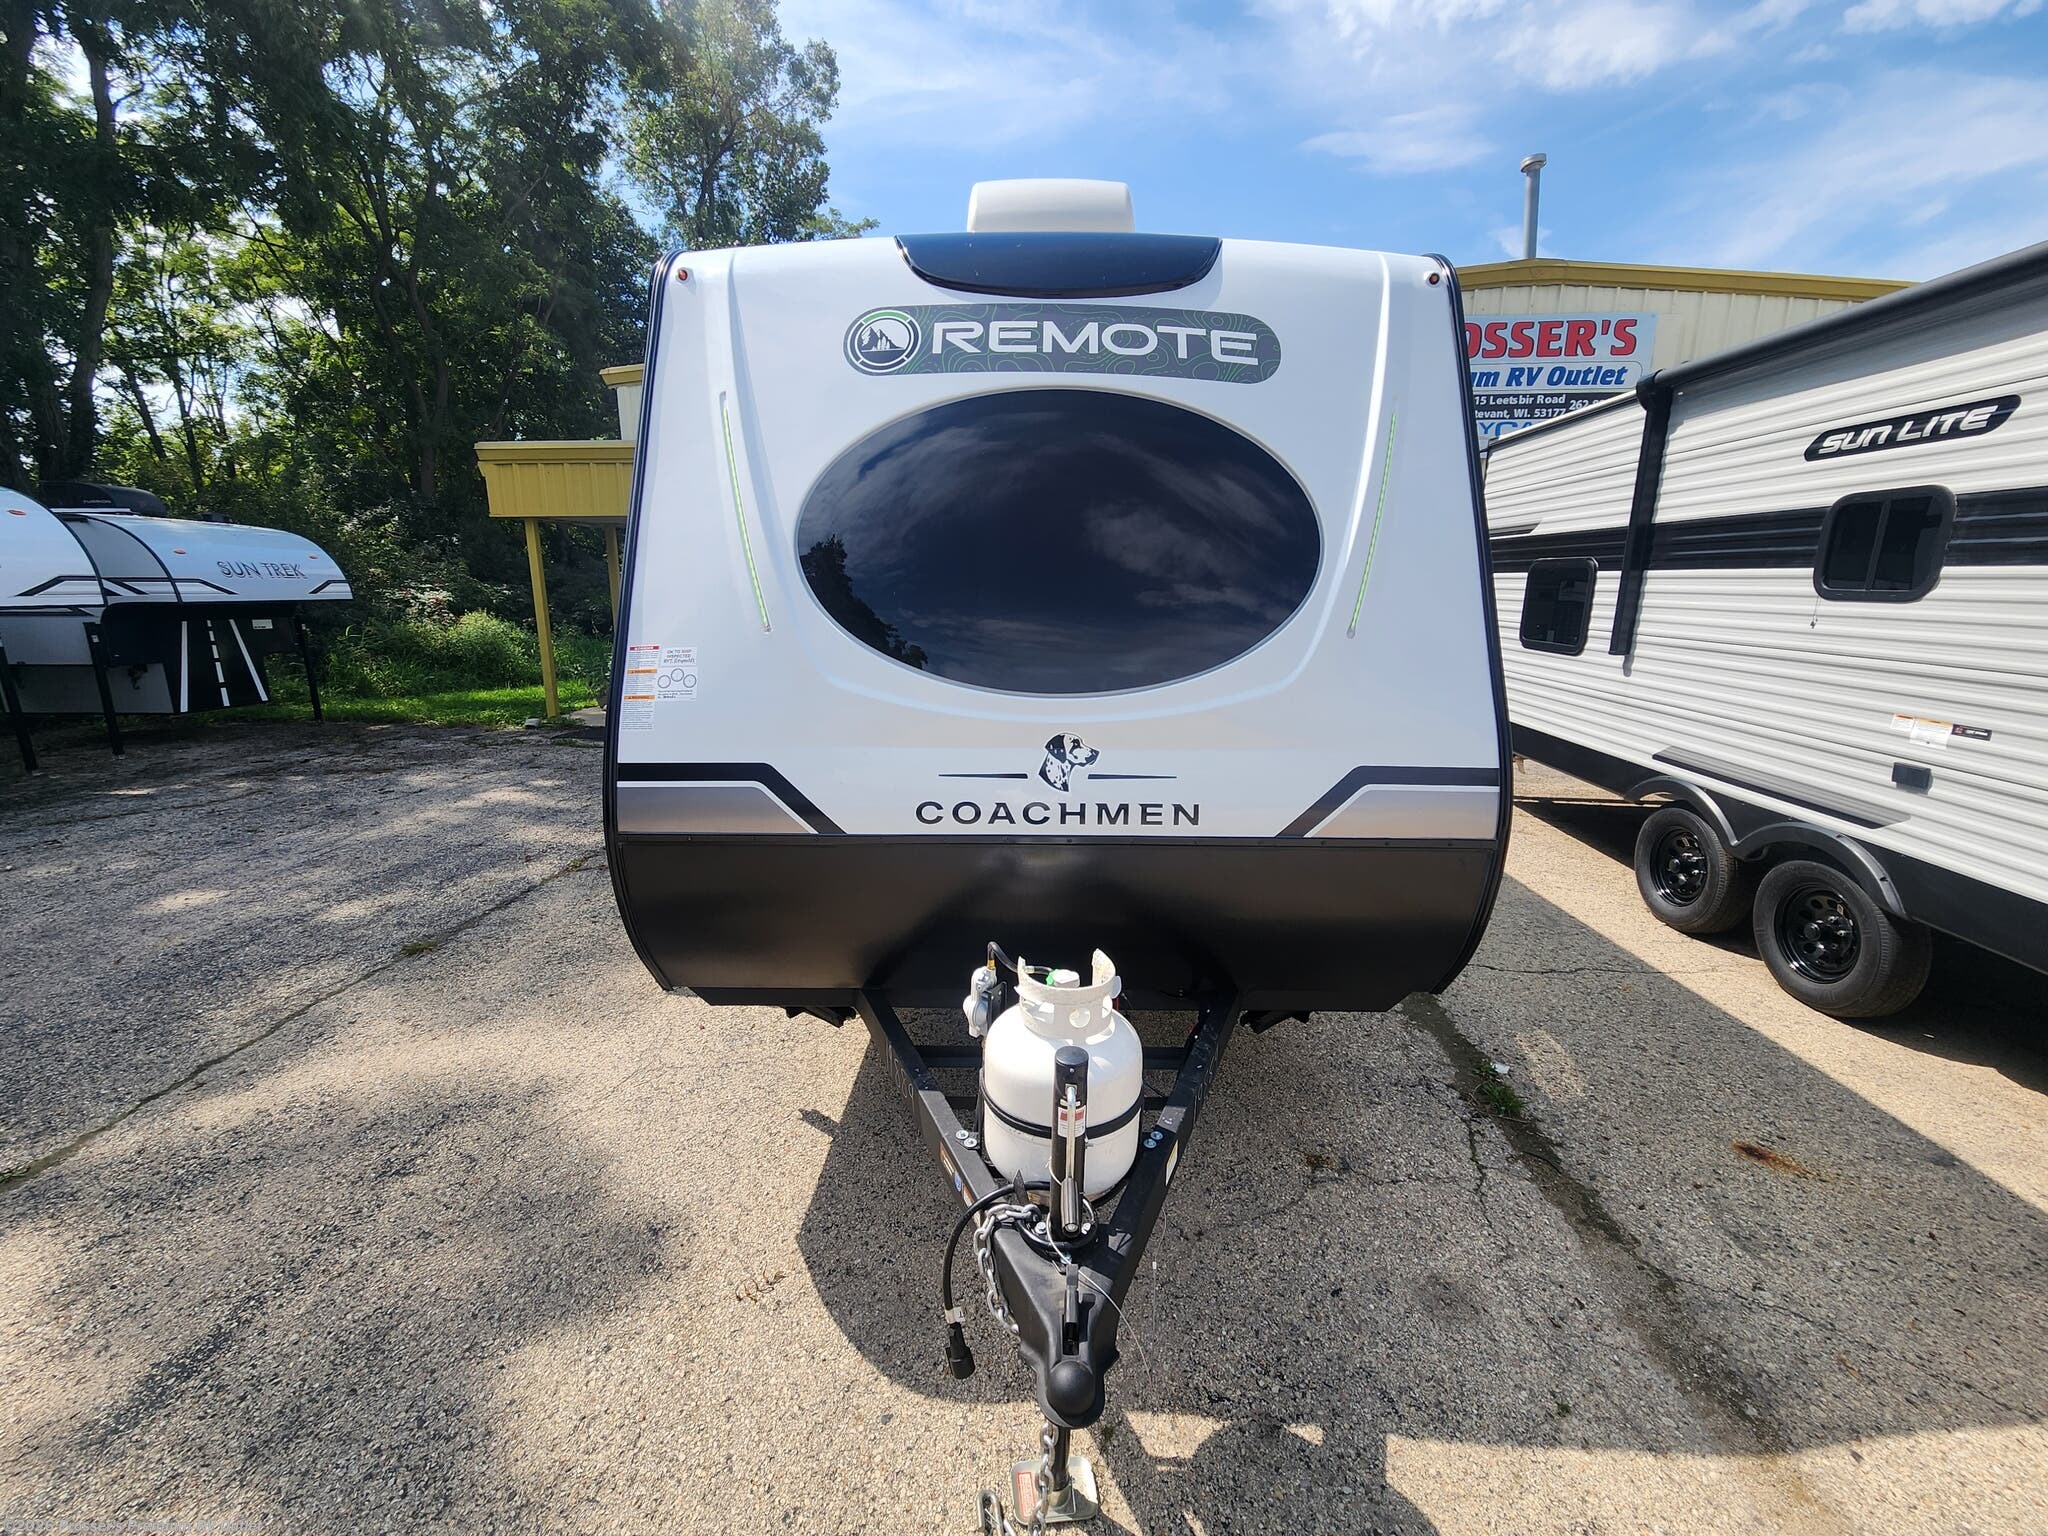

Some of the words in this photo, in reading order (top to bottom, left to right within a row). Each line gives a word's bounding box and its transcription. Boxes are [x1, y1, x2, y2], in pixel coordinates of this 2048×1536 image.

[931, 320, 1259, 365] REMOTE
[1464, 319, 1638, 358] OSSER'S
[1505, 367, 1544, 387] RV
[1546, 366, 1628, 386] Outlet
[1489, 395, 1534, 405] Leetsbir
[1536, 394, 1566, 404] Road
[1514, 408, 1531, 418] WI.
[1534, 408, 1566, 418] 53177
[1896, 405, 1998, 442] LITE
[217, 561, 261, 577] SUN
[261, 562, 306, 577] TREK
[915, 801, 1200, 825] COACHMEN
